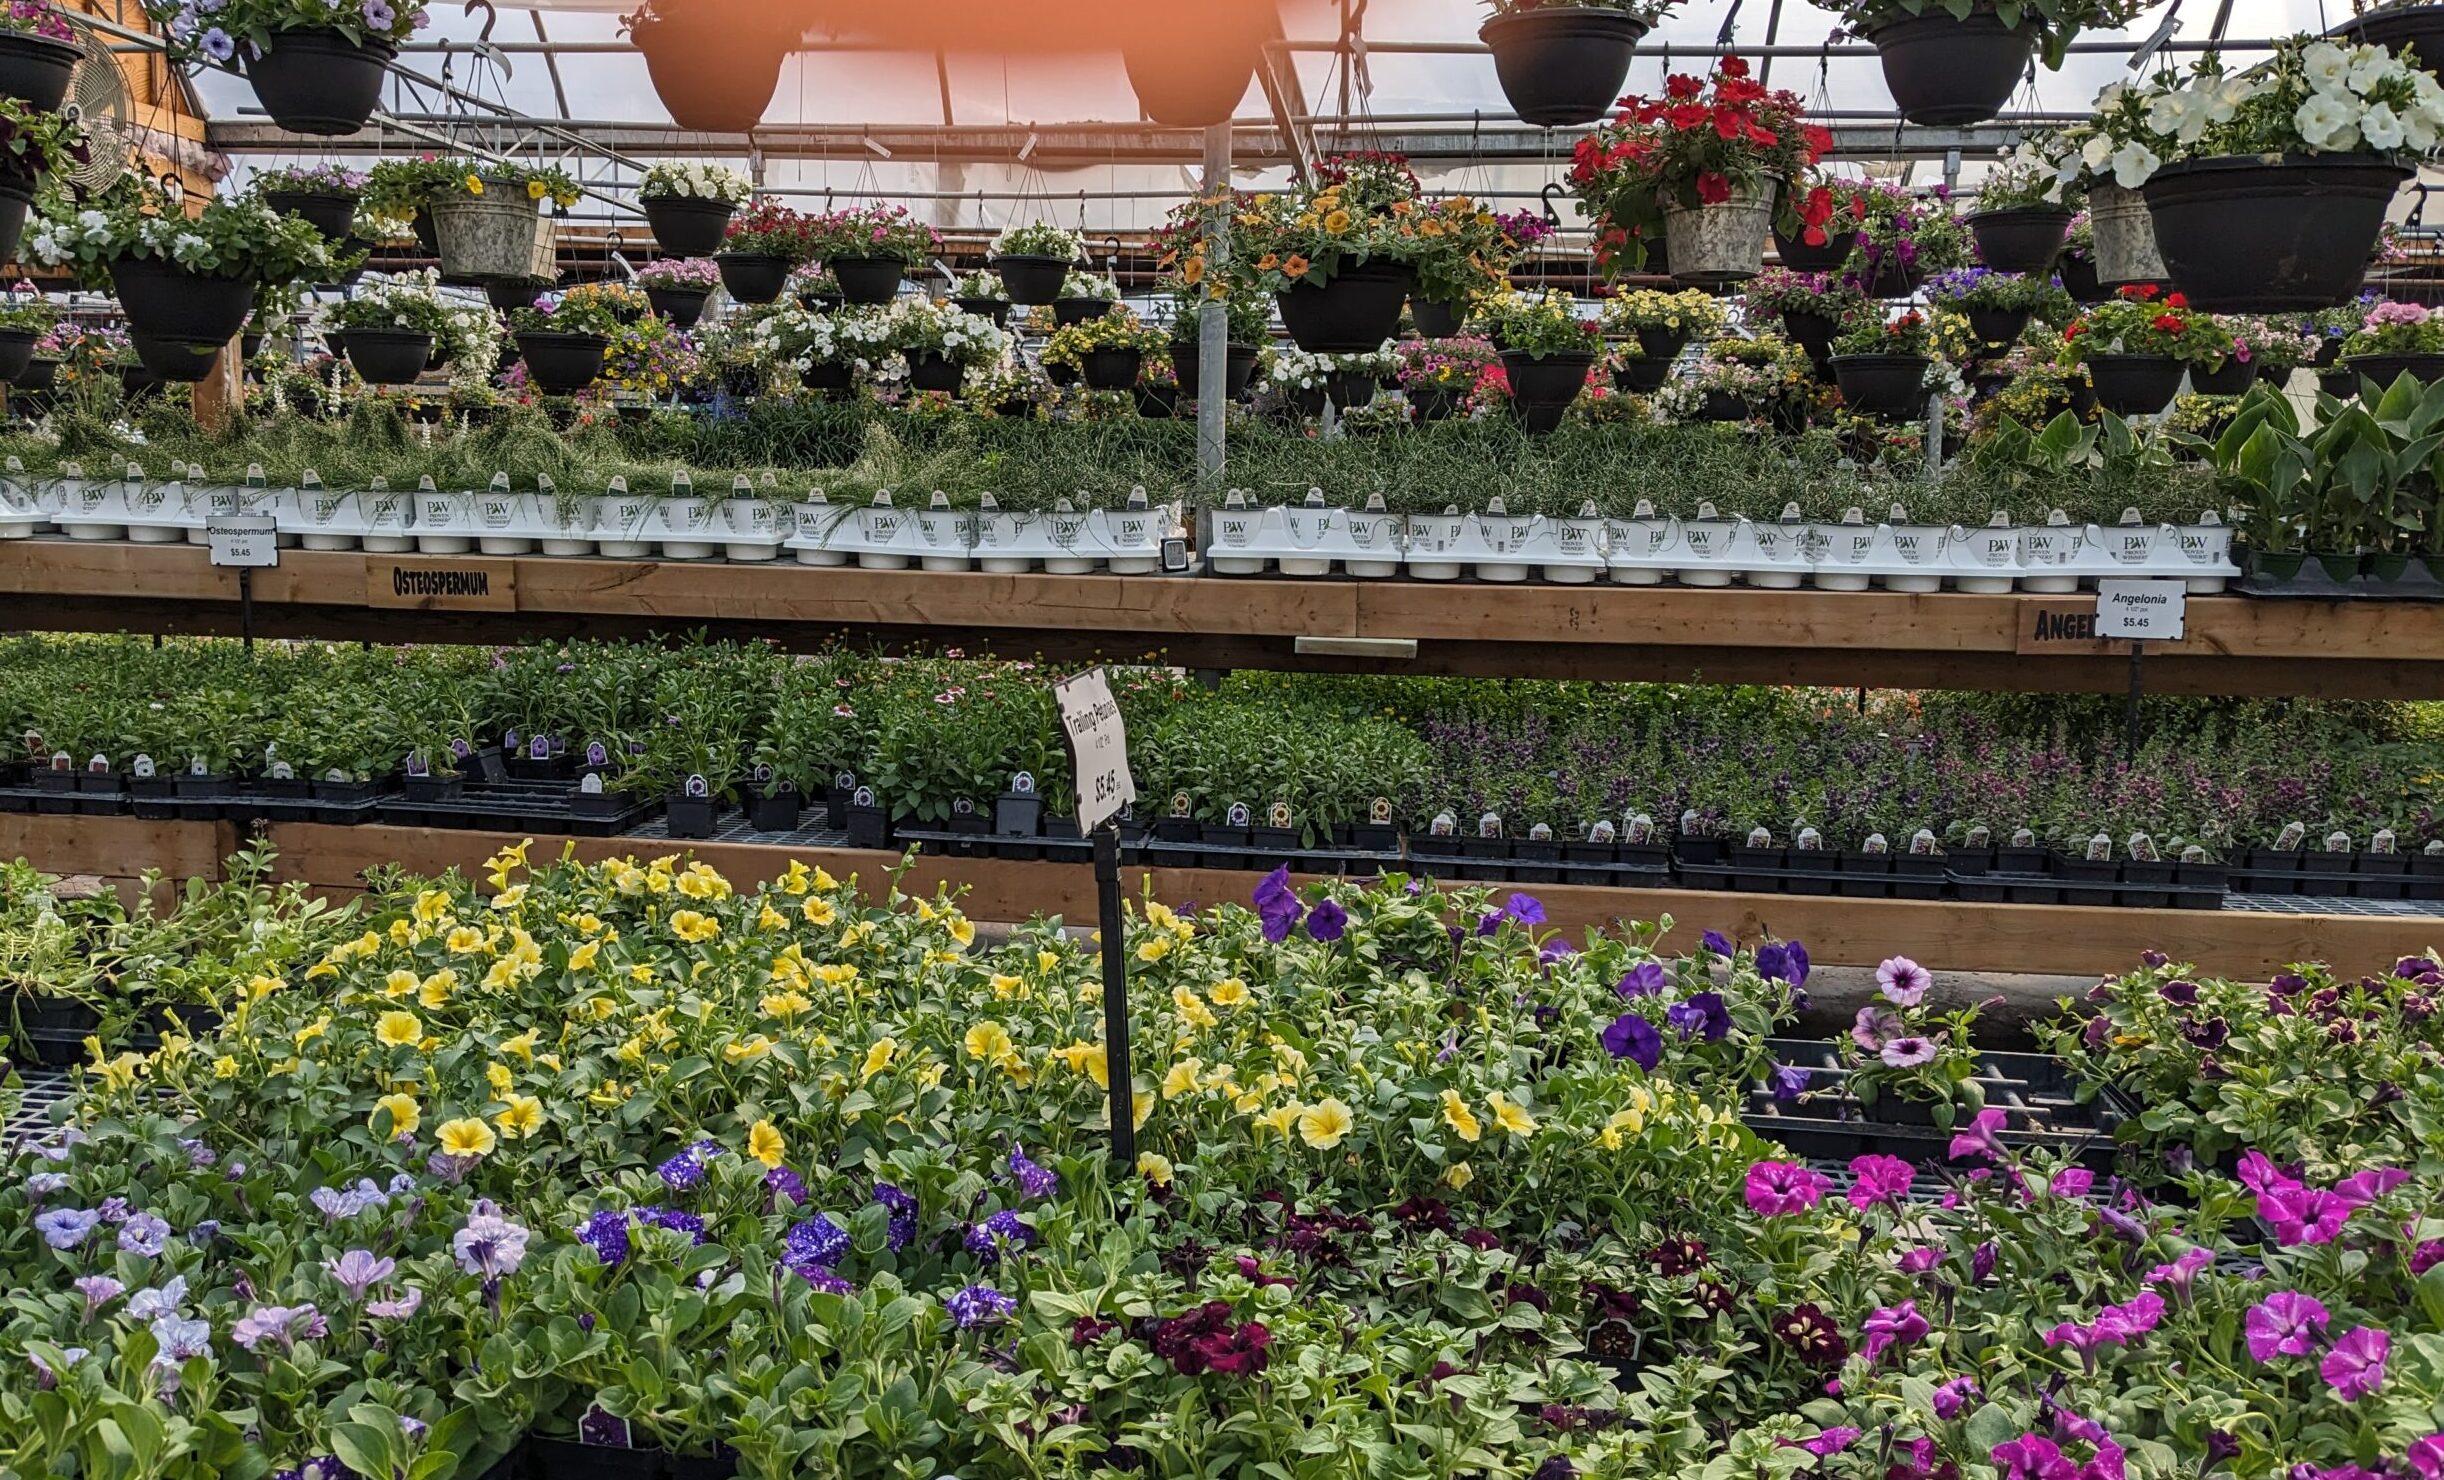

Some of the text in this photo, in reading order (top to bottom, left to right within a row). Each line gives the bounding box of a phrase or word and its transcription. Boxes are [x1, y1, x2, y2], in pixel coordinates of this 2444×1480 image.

[211, 495, 235, 507] PW
[427, 501, 450, 513] PW
[486, 502, 509, 514] PW
[799, 512, 819, 524] PW
[875, 517, 897, 530] PW
[209, 526, 273, 537] Osteospermum
[1055, 521, 1079, 533] PW
[1122, 520, 1145, 533] PW
[1223, 521, 1246, 533] PW
[1350, 521, 1371, 533] PW
[1412, 524, 1432, 536] PW
[1561, 528, 1585, 540] PW
[1687, 531, 1711, 543] PW
[1895, 537, 1919, 549] PW
[1989, 539, 2012, 552] PW
[2029, 536, 2053, 549] PW
[2124, 536, 2149, 549] PW
[2181, 535, 2207, 548] PW
[230, 548, 251, 557] $5.45
[2111, 593, 2167, 606] Angelonia
[2123, 617, 2149, 628] $5.45
[1066, 710, 1097, 737] Trailing
[1096, 769, 1116, 803] $5.45
